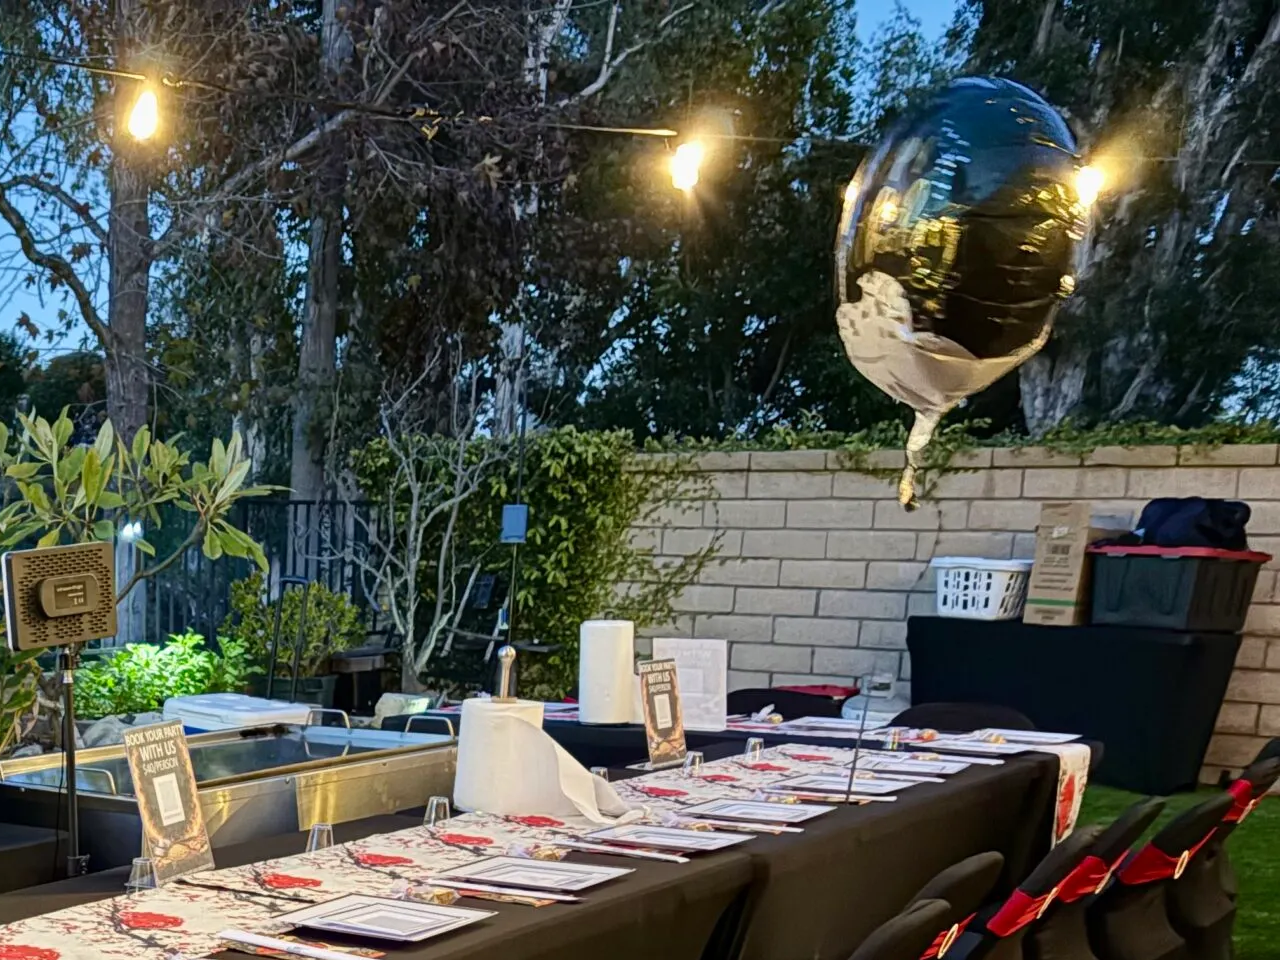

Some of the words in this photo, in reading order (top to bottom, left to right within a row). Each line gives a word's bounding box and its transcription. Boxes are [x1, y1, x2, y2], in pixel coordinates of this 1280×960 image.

[124, 731, 145, 747] BOOK
[144, 728, 164, 743] YOUR
[139, 742, 164, 762] WITH
[163, 740, 176, 756] US
